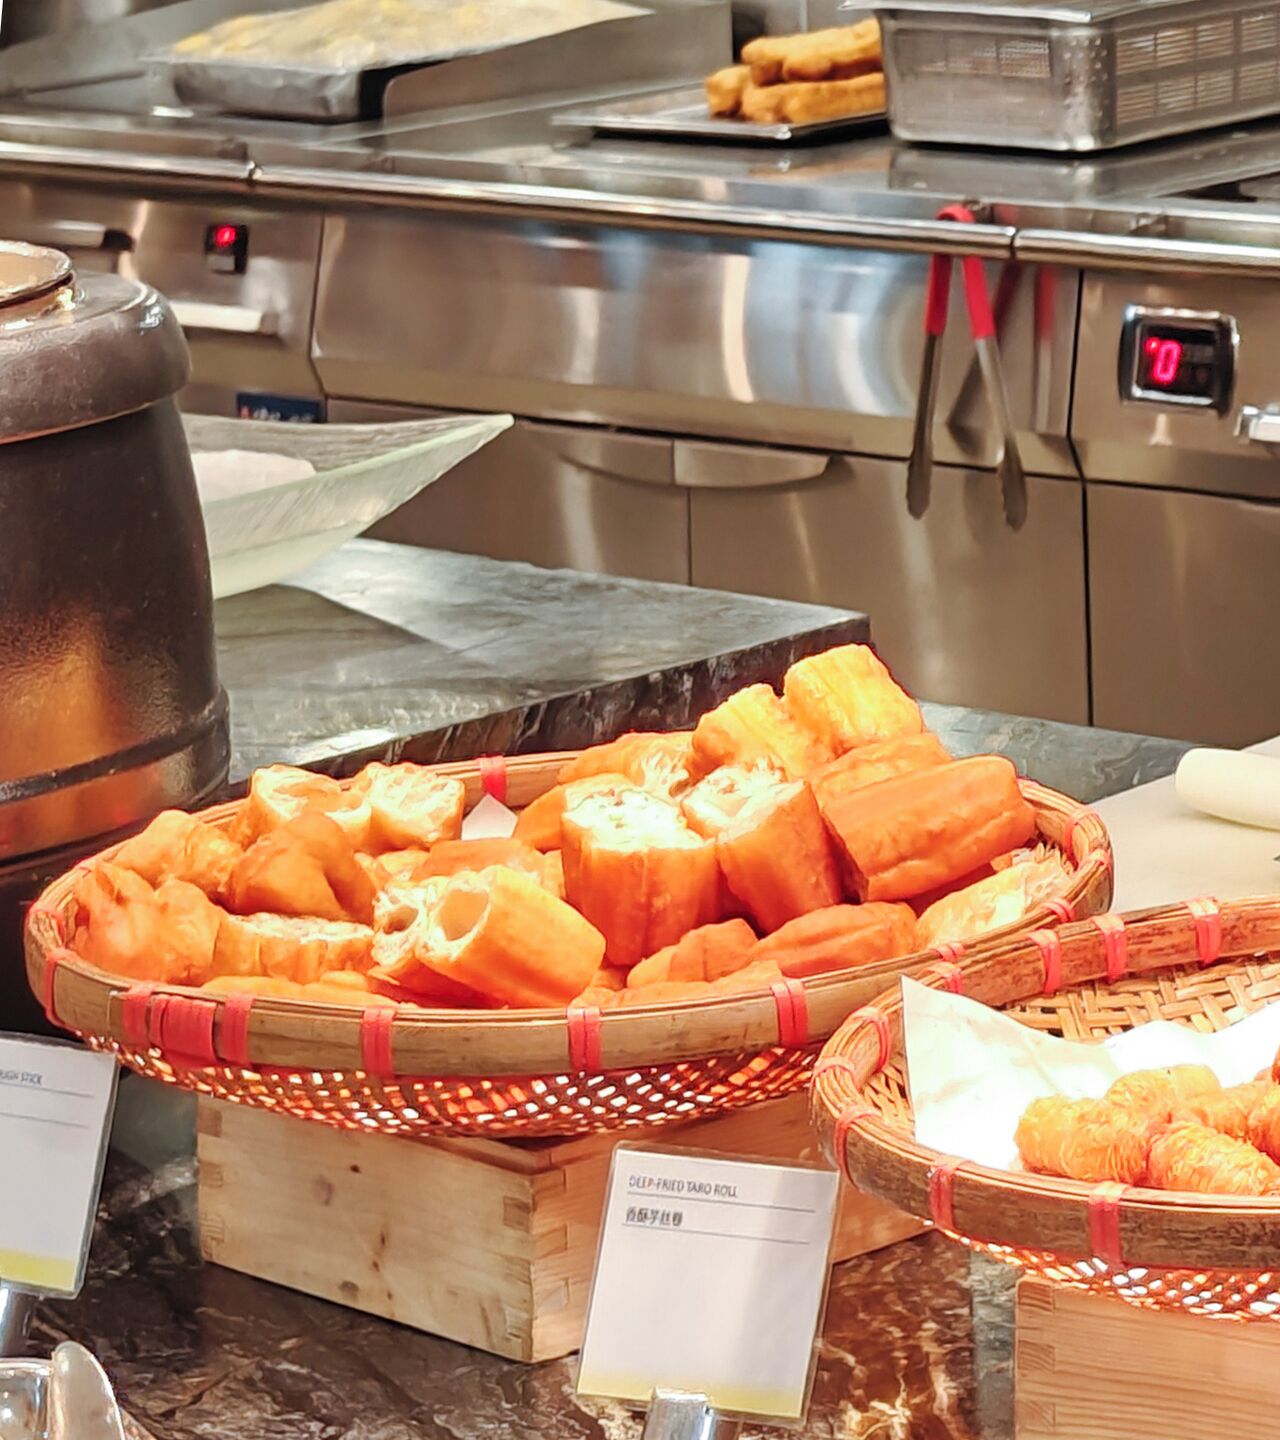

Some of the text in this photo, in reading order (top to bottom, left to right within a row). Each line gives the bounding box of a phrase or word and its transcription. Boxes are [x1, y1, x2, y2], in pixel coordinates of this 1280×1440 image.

[628, 1174, 738, 1199] DEEP-FRIED TARO ROLL
